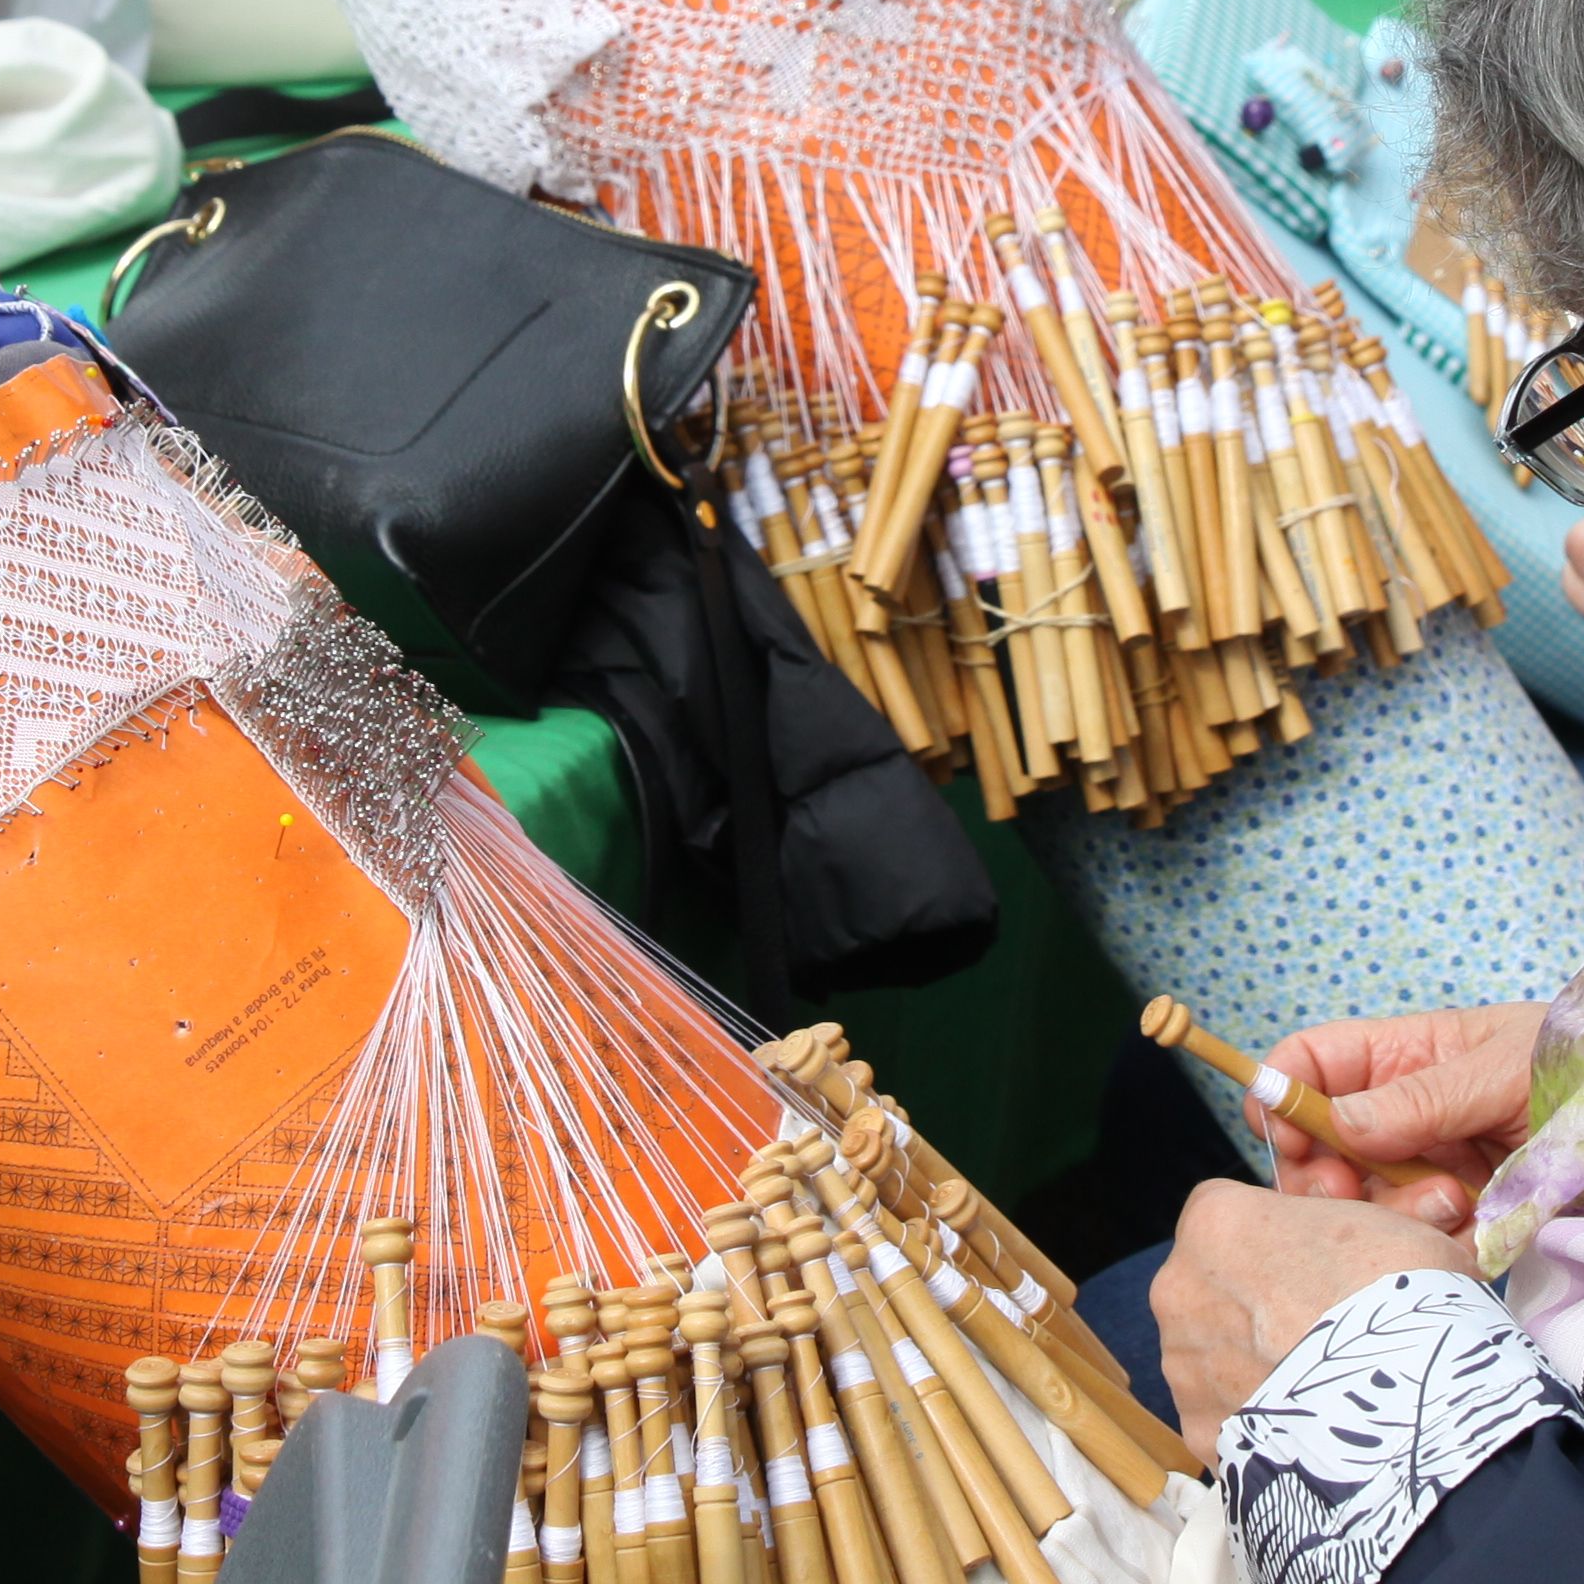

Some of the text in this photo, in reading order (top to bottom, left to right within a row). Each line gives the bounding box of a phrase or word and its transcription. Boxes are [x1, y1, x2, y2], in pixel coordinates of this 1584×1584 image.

[295, 956, 313, 974] 50
[279, 969, 296, 986] de
[299, 964, 332, 993] Punta
[244, 983, 282, 1018] Brodar
[280, 991, 301, 1010] 72
[232, 1015, 242, 1026] a
[249, 1014, 274, 1038] 104
[205, 1033, 250, 1074] boixets
